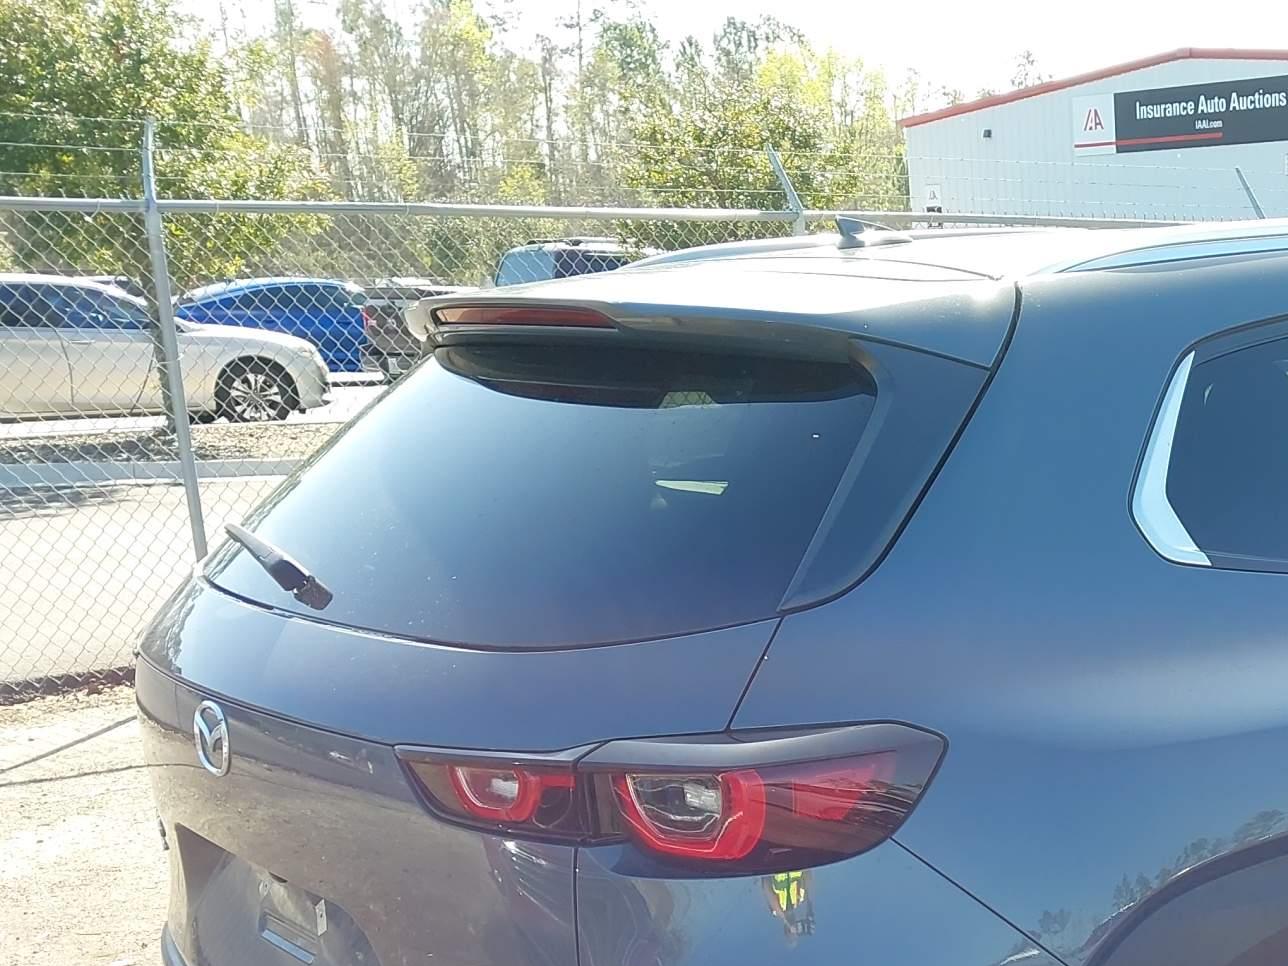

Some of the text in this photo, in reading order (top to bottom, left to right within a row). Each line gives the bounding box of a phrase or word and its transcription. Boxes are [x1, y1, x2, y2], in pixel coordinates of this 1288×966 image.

[1136, 89, 1287, 119] Insurance Auto Auctions
[1195, 119, 1223, 129] IAAI.com
